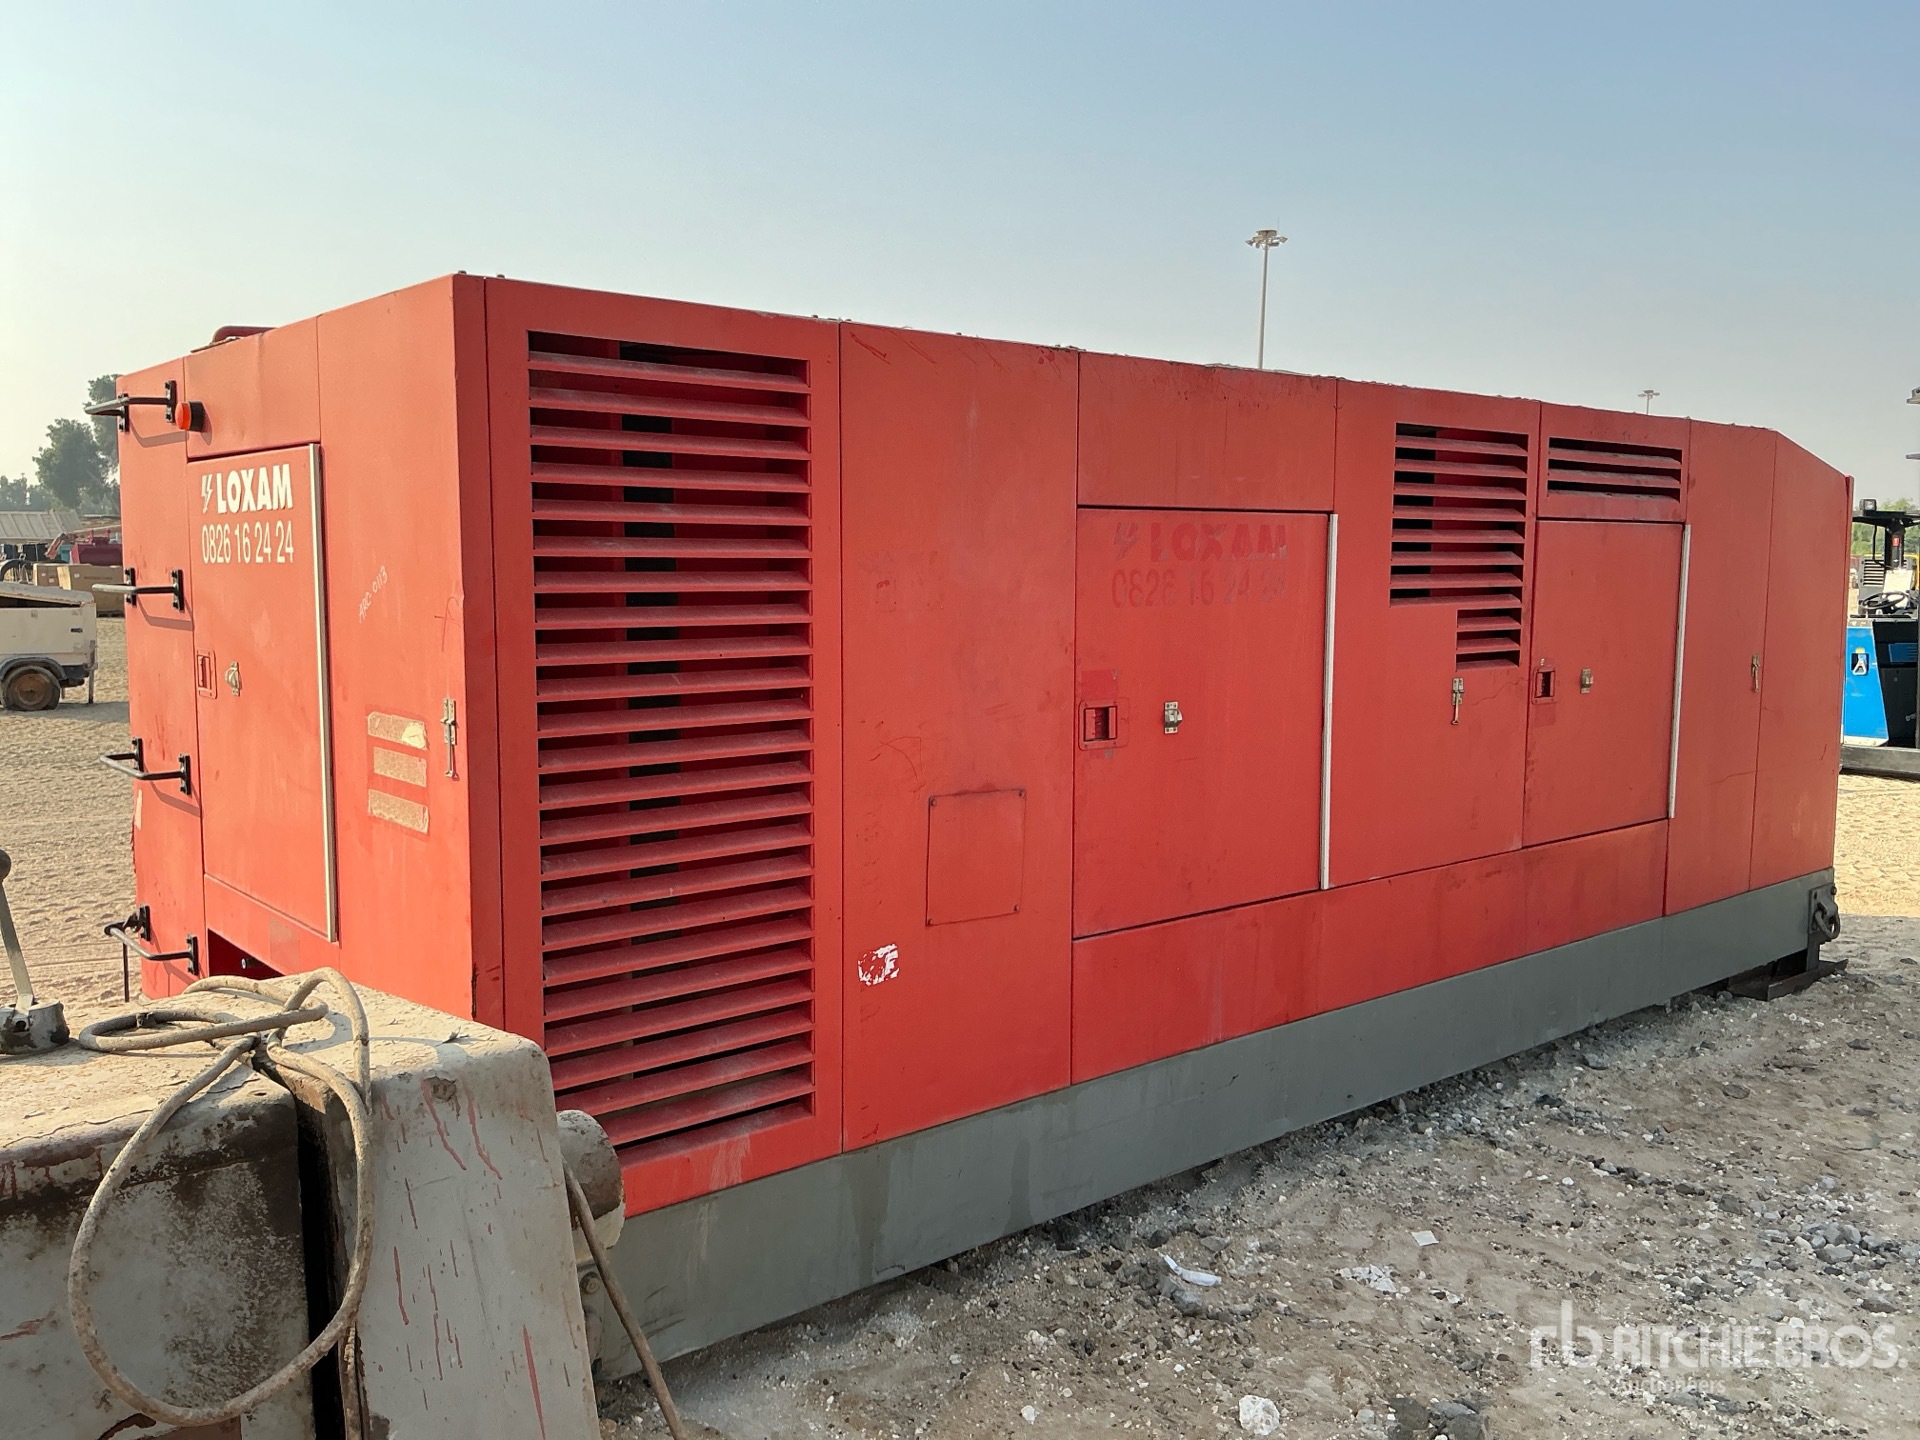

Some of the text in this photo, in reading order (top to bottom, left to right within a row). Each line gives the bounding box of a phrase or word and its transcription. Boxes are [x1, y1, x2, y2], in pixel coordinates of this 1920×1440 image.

[216, 463, 293, 514] LOXAM
[201, 519, 294, 564] 0826 16 24 24
[1151, 522, 1288, 562] LOXAM
